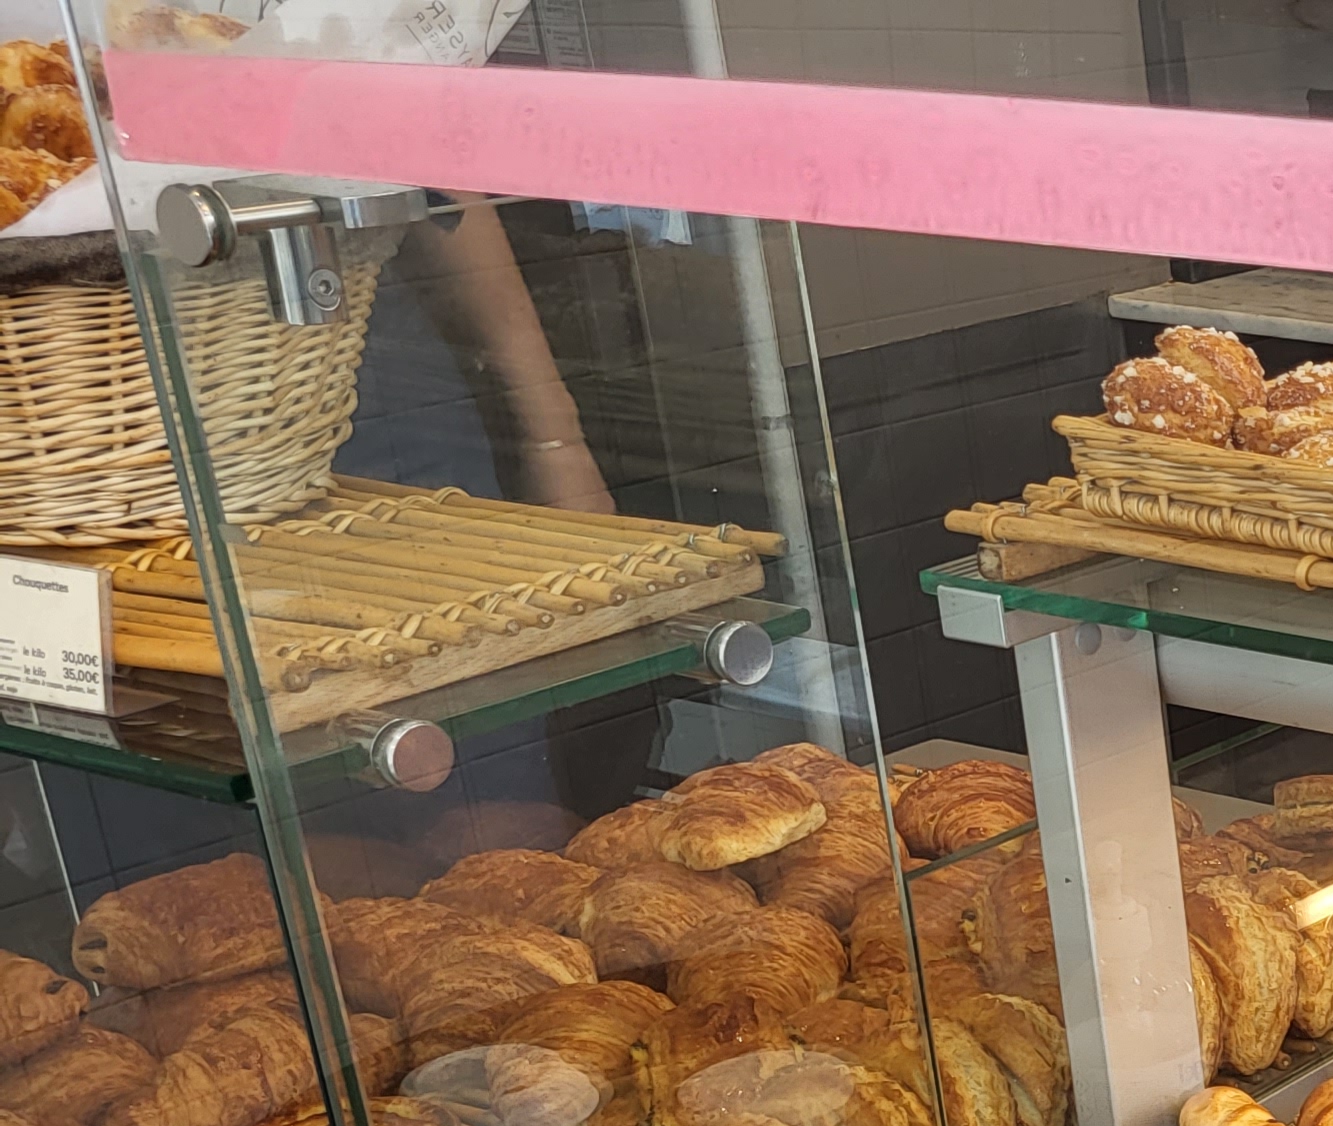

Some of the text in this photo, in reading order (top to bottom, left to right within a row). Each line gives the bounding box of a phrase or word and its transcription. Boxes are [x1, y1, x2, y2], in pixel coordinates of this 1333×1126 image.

[13, 575, 69, 593] Chouquettes
[62, 650, 99, 667] 30,00€
[63, 667, 99, 684] 35,00€
